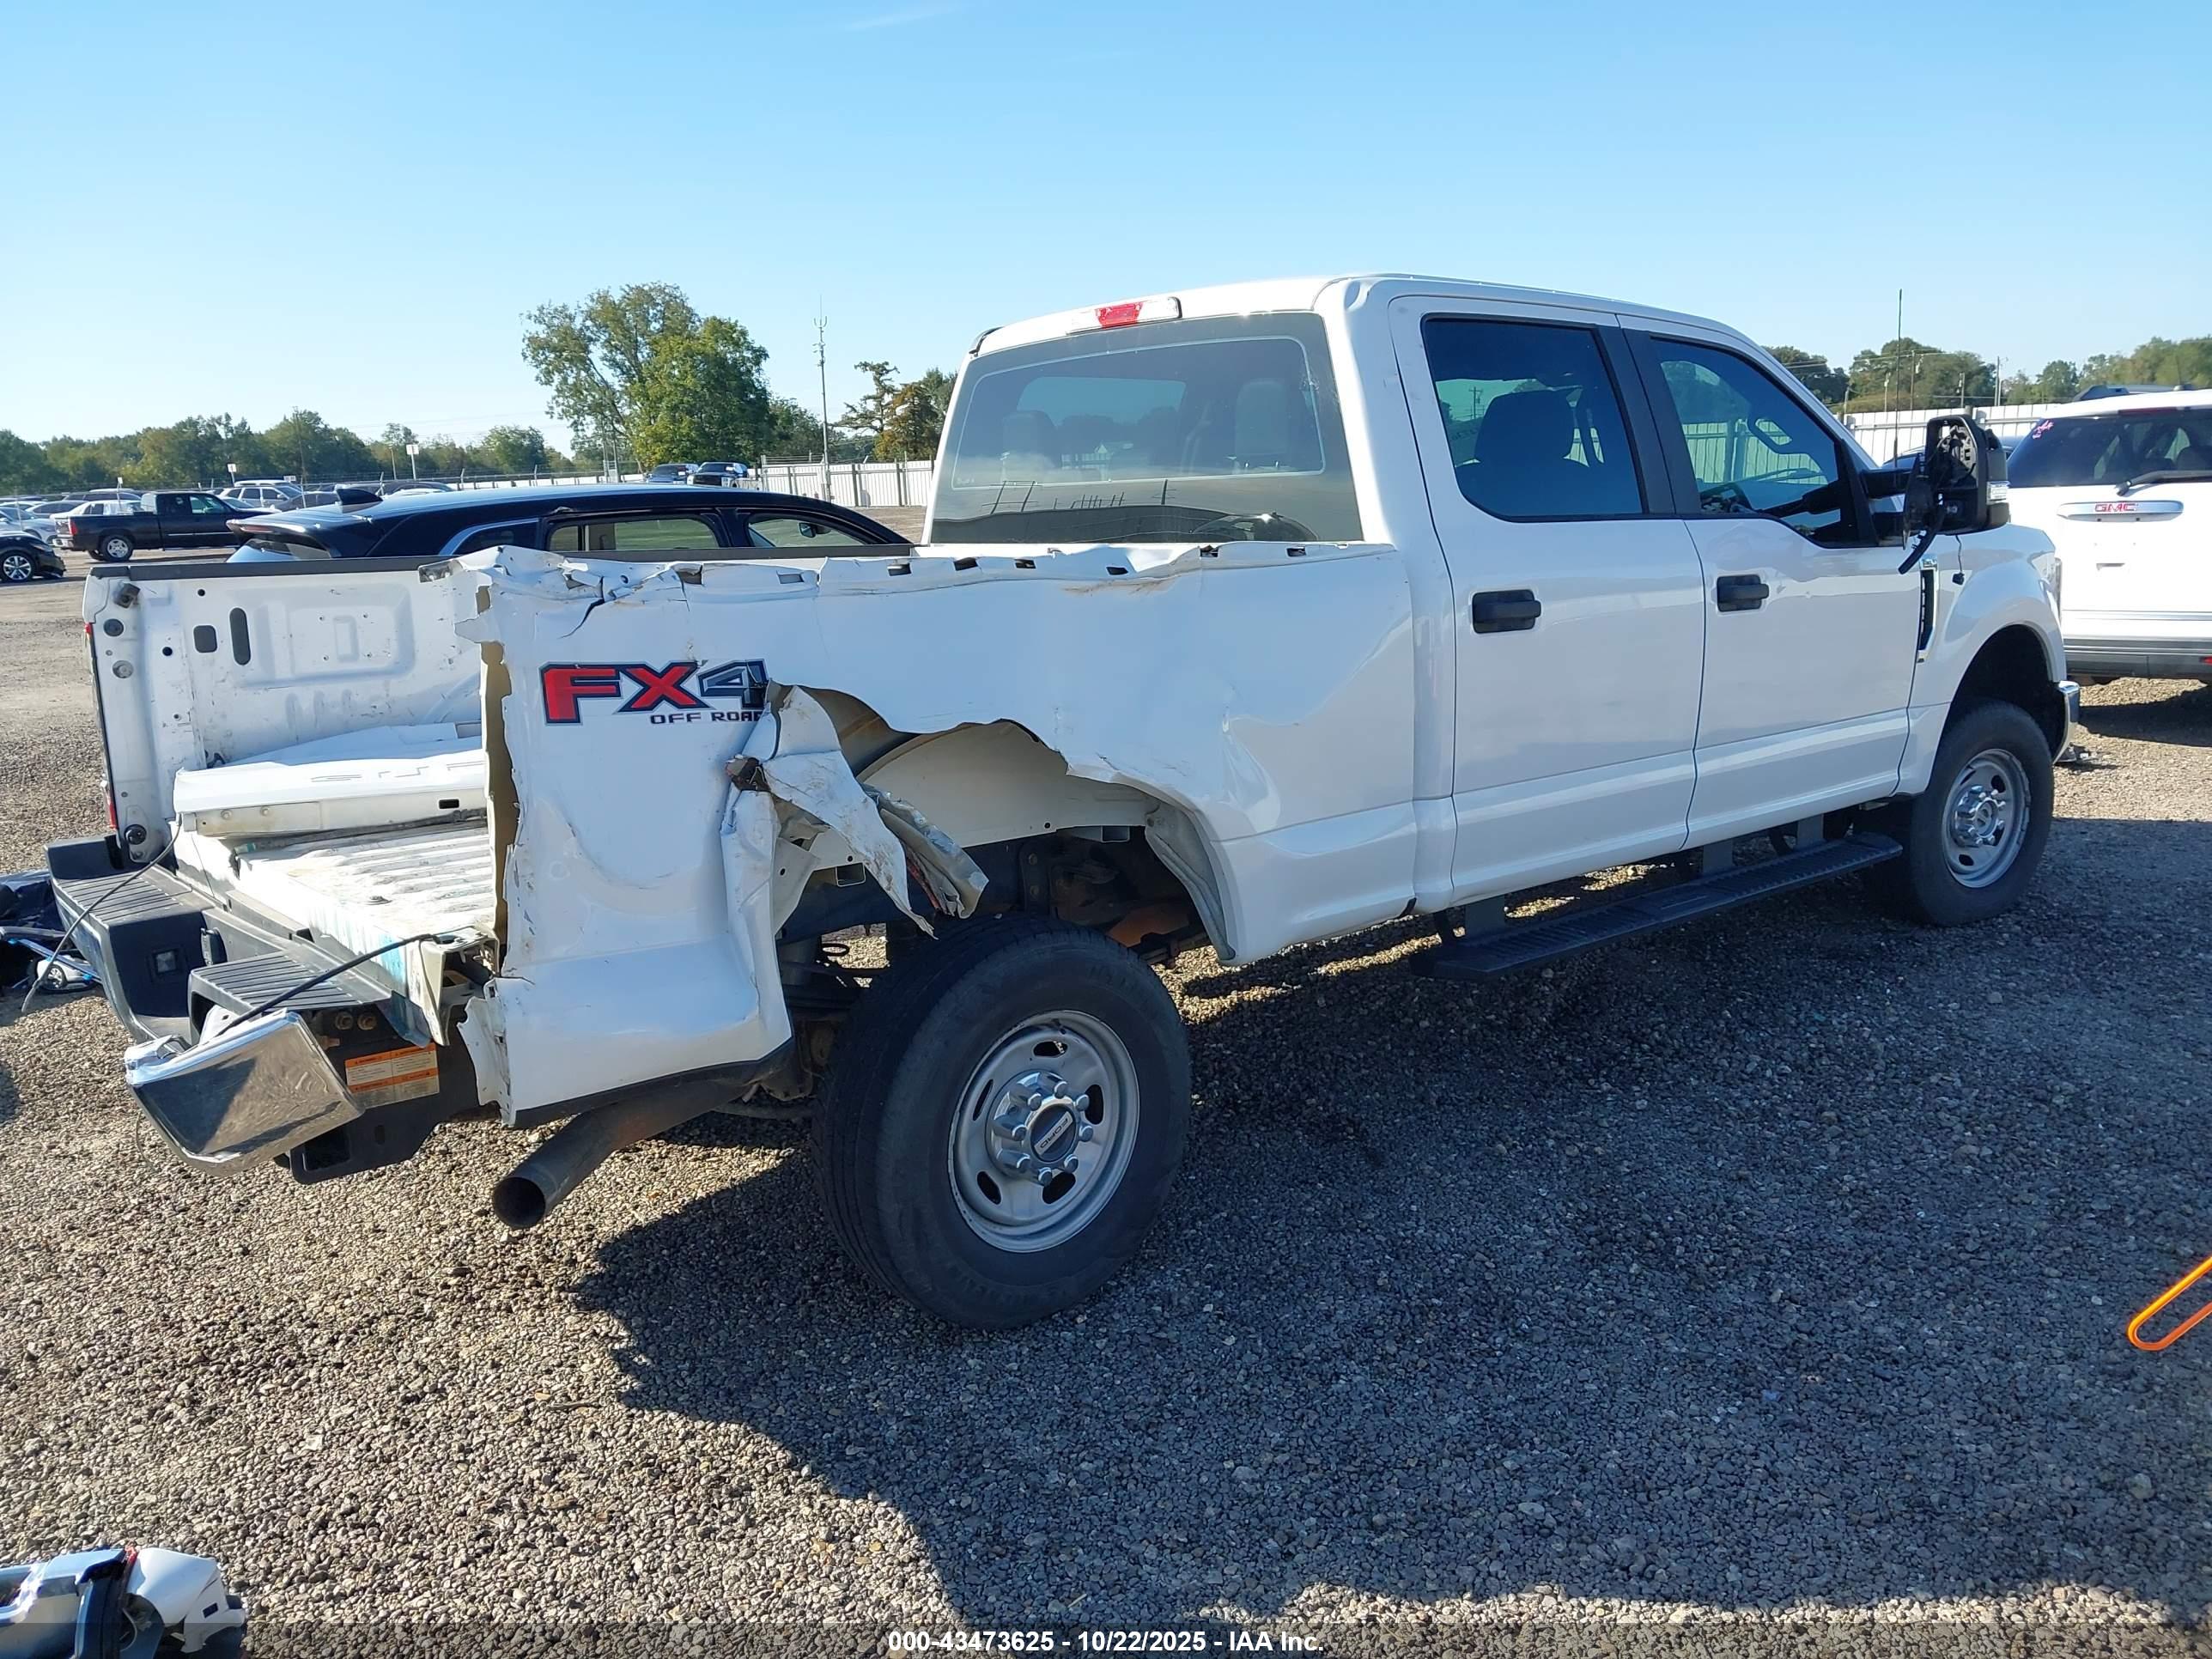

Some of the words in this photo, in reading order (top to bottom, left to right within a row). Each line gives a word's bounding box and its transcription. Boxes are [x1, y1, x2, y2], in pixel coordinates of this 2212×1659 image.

[2095, 502, 2136, 513] GMC
[539, 659, 769, 726] FX4
[650, 711, 702, 725] OFF
[1039, 1118, 1068, 1149] FORD
